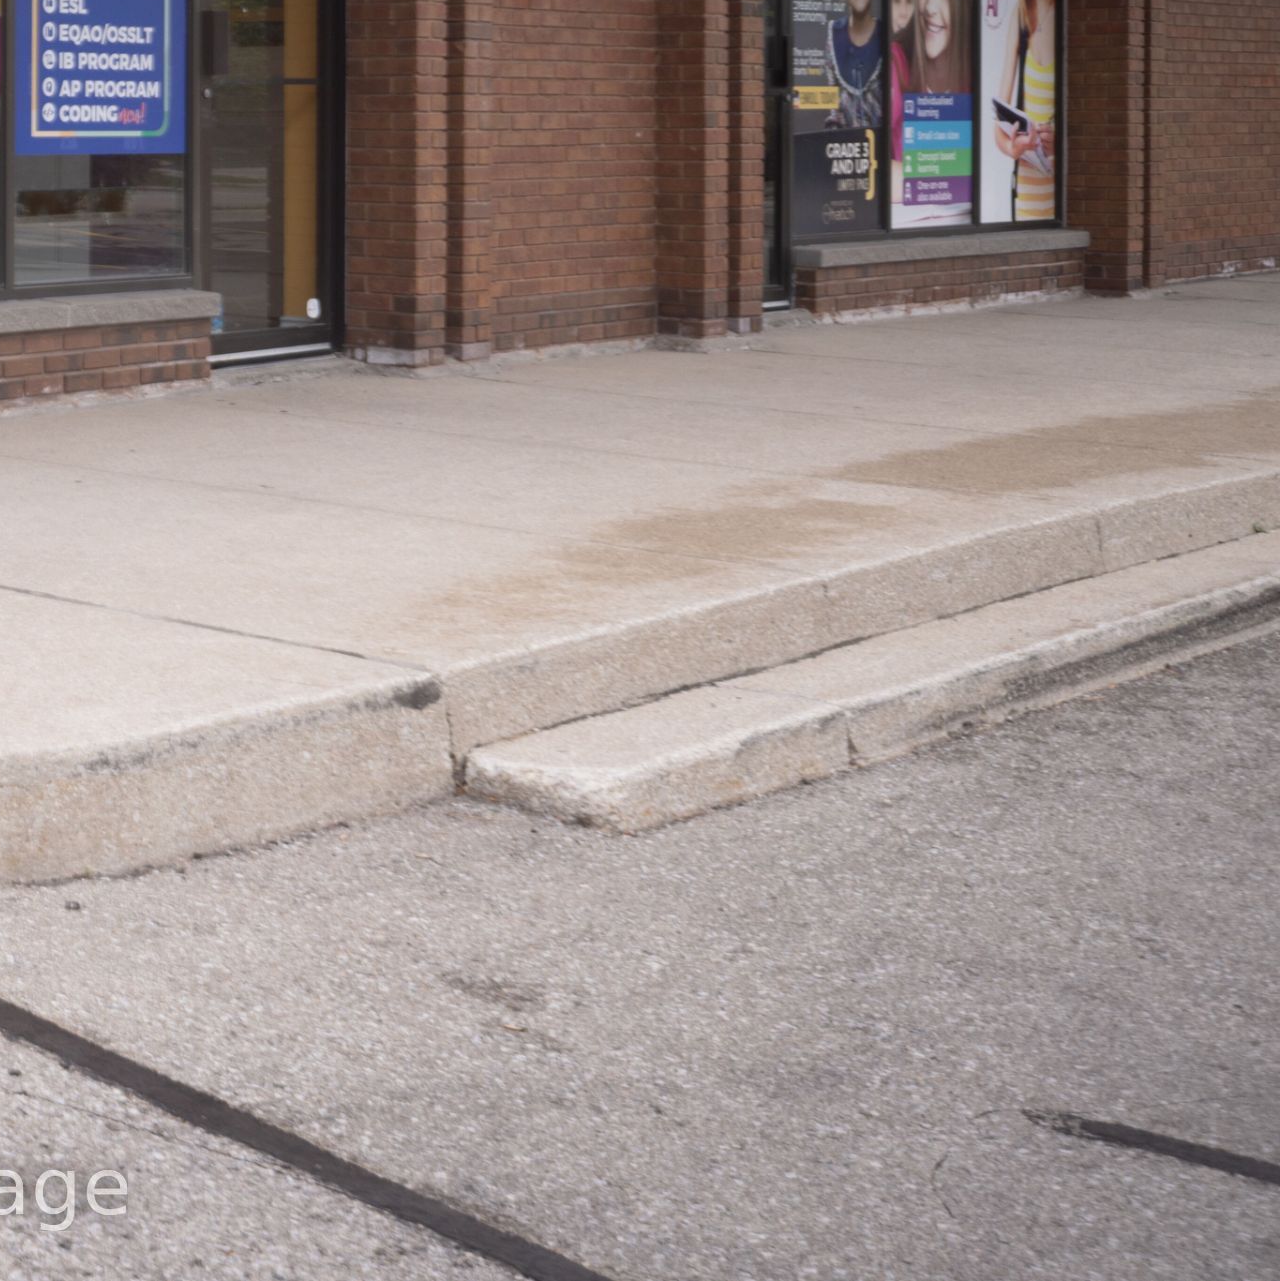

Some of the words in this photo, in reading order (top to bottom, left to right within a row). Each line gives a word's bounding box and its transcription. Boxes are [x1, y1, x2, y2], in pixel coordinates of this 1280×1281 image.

[59, 23, 155, 45] EQAO/OSSLT
[59, 52, 75, 69] IB
[78, 52, 154, 71] PROGRAM
[59, 79, 82, 97] AP
[84, 80, 160, 98] PROGRAM
[59, 105, 118, 123] CODING
[826, 142, 860, 158] GRADE
[861, 142, 869, 158] 3
[831, 159, 853, 175] AND
[855, 159, 869, 174] UP
